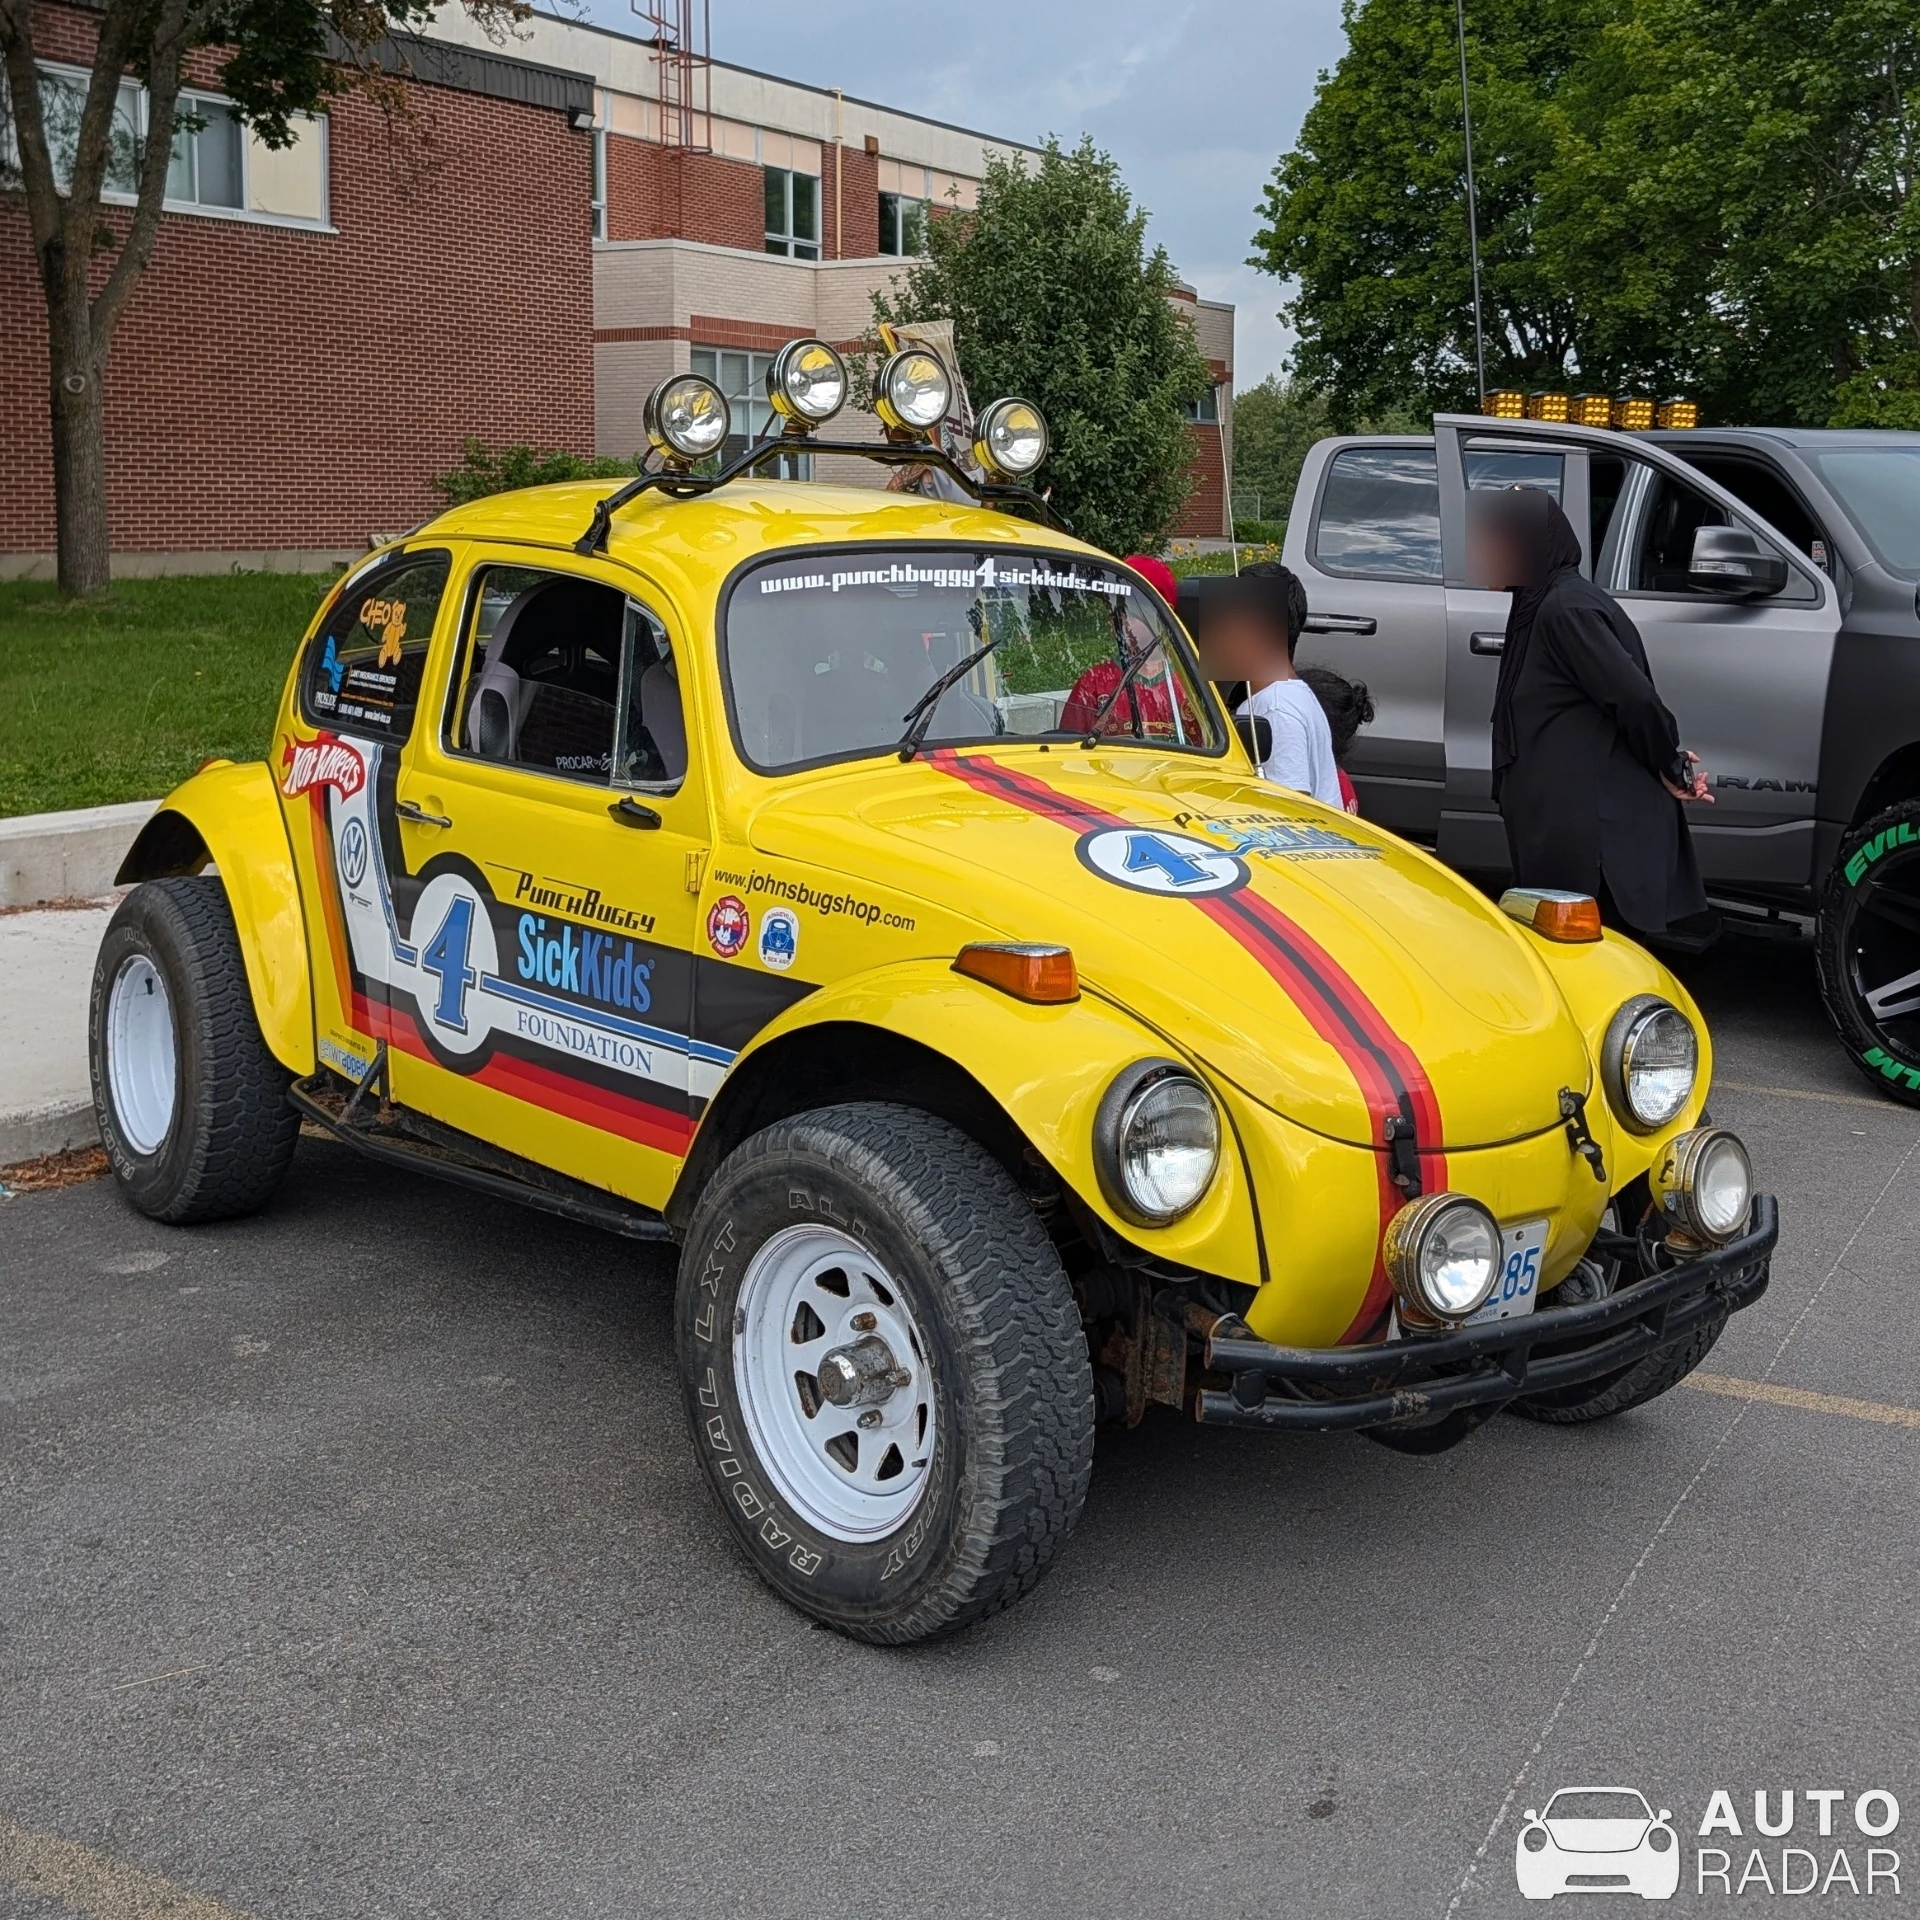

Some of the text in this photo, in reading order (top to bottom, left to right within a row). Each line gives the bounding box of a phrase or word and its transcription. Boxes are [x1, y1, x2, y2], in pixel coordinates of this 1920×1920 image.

[760, 558, 1132, 597] www.punchbuggy4sickkids.com
[360, 598, 391, 630] CHEO
[556, 756, 595, 769] PROCAR
[1717, 774, 1818, 793] RAM
[1122, 833, 1219, 887] 4
[1844, 822, 1920, 887] EVIL
[714, 869, 916, 932] www.johnsbugshop.com
[422, 894, 477, 1036] 4
[320, 1038, 369, 1078] getwrapped
[517, 1009, 653, 1074] FOUNDATION
[788, 1190, 880, 1255] ALL
[1484, 1246, 1541, 1306] 85
[694, 1220, 822, 1576] RADIAL LXT
